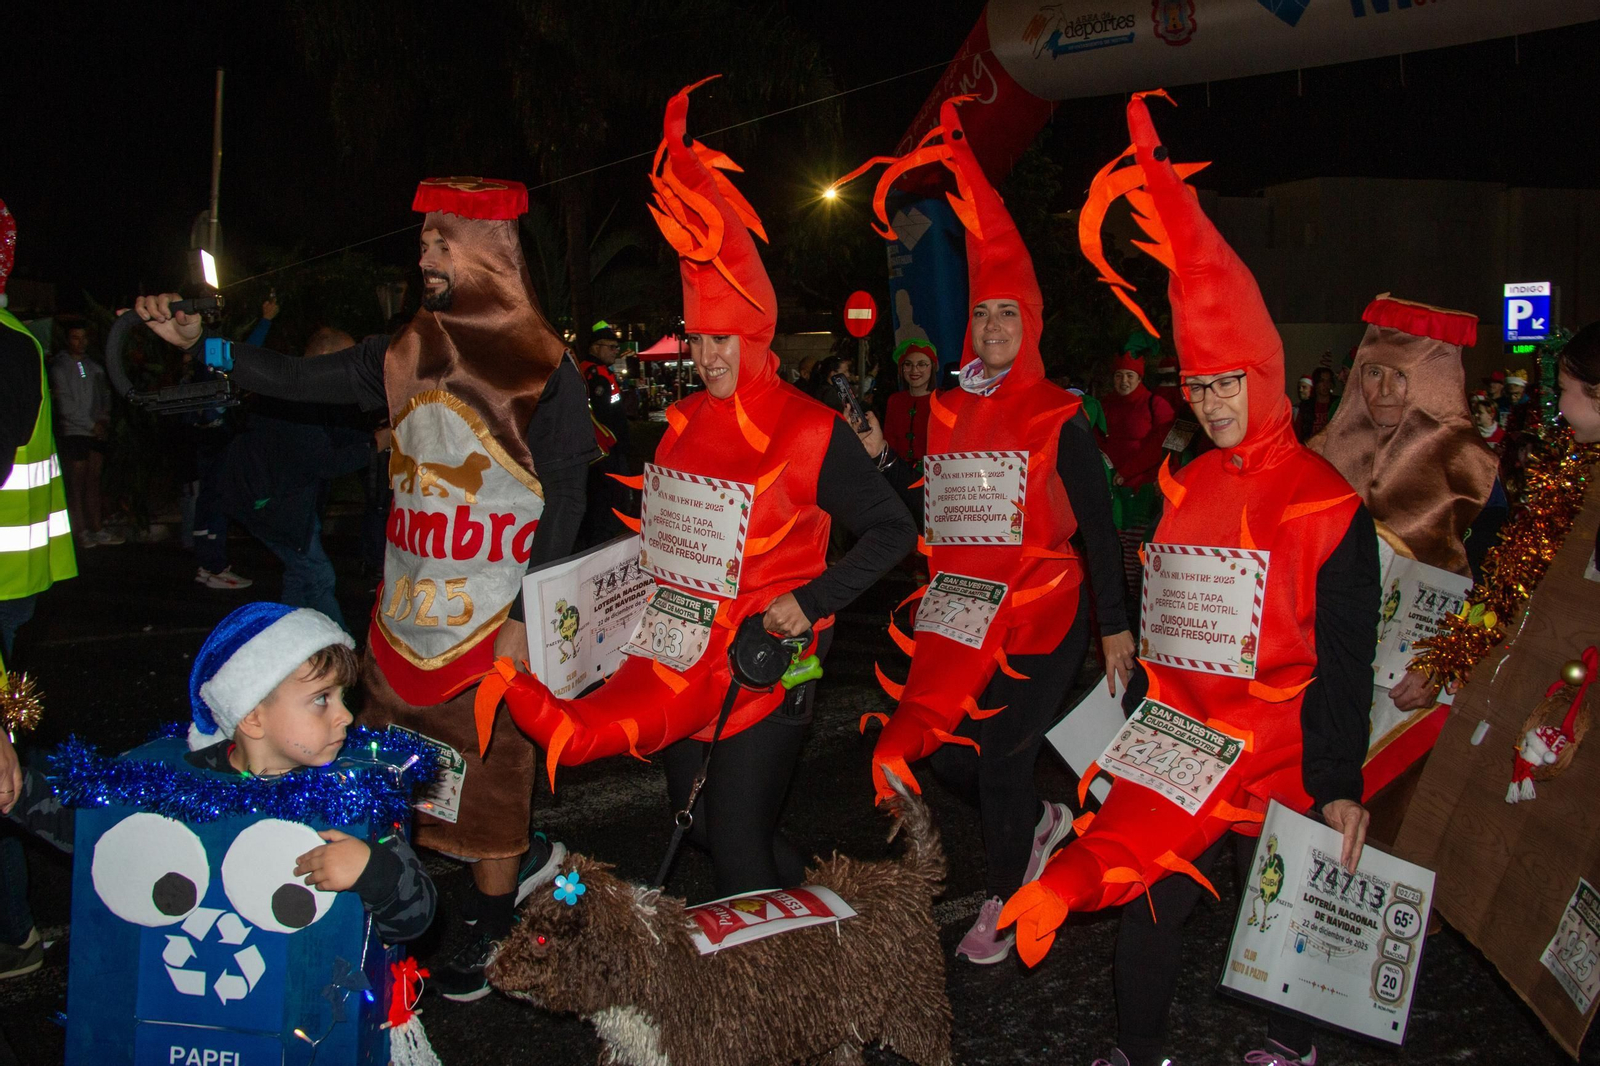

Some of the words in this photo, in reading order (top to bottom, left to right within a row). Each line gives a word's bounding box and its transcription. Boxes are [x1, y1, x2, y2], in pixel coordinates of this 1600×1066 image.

[1064, 14, 1135, 40] deportes
[1509, 285, 1544, 293] INDIGO
[1508, 299, 1533, 330] P
[938, 494, 966, 502] PERFECTA
[968, 493, 977, 501] DE
[945, 486, 965, 494] SOMOS
[658, 490, 668, 499] SAN
[668, 491, 703, 509] SILVESTRE
[705, 501, 725, 513] 2025
[944, 505, 985, 516] QUISQUILLA
[654, 515, 680, 531] PERFECTA
[682, 523, 692, 534] DE
[693, 526, 726, 541] MOTRIL:
[660, 508, 680, 521] SOMOS
[682, 513, 691, 524] LA
[693, 516, 713, 529] TAPA
[934, 514, 961, 523] CERVEZA
[963, 514, 1007, 523] FRESQUITA
[649, 537, 675, 555] CERVEZA
[675, 547, 723, 567] FRESQUITA
[657, 531, 699, 550] QUISQUILLA
[701, 542, 708, 552] Y
[594, 555, 640, 597] 7471
[943, 576, 958, 585] SAN
[958, 579, 995, 591] SILVESTRE
[1160, 569, 1171, 578] SAN
[1170, 571, 1211, 583] SILVESTRE
[1213, 575, 1235, 585] 2025
[594, 593, 621, 612] LOTERÍA
[623, 578, 656, 596] NACIONA
[605, 606, 613, 615] DE
[615, 590, 646, 609] NAVIDAD
[1162, 588, 1185, 599] SOMOS
[1187, 592, 1197, 600] LA
[1199, 593, 1224, 603] TAPA
[1415, 588, 1465, 615] 7471
[611, 604, 634, 620] diciembre
[668, 604, 674, 612] DE
[703, 607, 712, 616] 19
[942, 600, 966, 624] 7
[1155, 598, 1185, 610] PERFECTA
[1187, 602, 1199, 611] DE
[1201, 604, 1239, 616] MOTRIL:
[1160, 614, 1208, 630] QUISQUILLA
[1210, 621, 1218, 630] Y
[1408, 611, 1433, 626] LOTERÍA
[652, 621, 684, 658] 83
[1150, 623, 1180, 638] CERVEZA
[1181, 629, 1237, 645] FRESQUITA
[1425, 624, 1451, 637] NAVIDA
[1146, 716, 1175, 732] CIUDAD
[1175, 729, 1187, 738] DE
[1186, 734, 1216, 754] MOTRIL
[1150, 706, 1173, 721] SAN
[1173, 715, 1226, 746] SILVESTRE
[1226, 743, 1237, 754] 19
[1126, 740, 1203, 786] 448
[1311, 858, 1386, 909] 74713
[1304, 892, 1336, 914] LOTERÍA
[1338, 906, 1378, 930] NACIONAL
[1315, 911, 1326, 922] DE
[1326, 915, 1362, 936] NAVIDAD
[1302, 919, 1310, 927] 22
[1310, 922, 1317, 931] de
[1318, 924, 1344, 942] diciembre
[1345, 936, 1353, 946] de
[1354, 939, 1369, 951] 2025
[1244, 948, 1257, 962] CLUB
[1385, 965, 1400, 975] PRECIO
[1382, 974, 1397, 990] 20
[1380, 989, 1395, 998] EUROS
